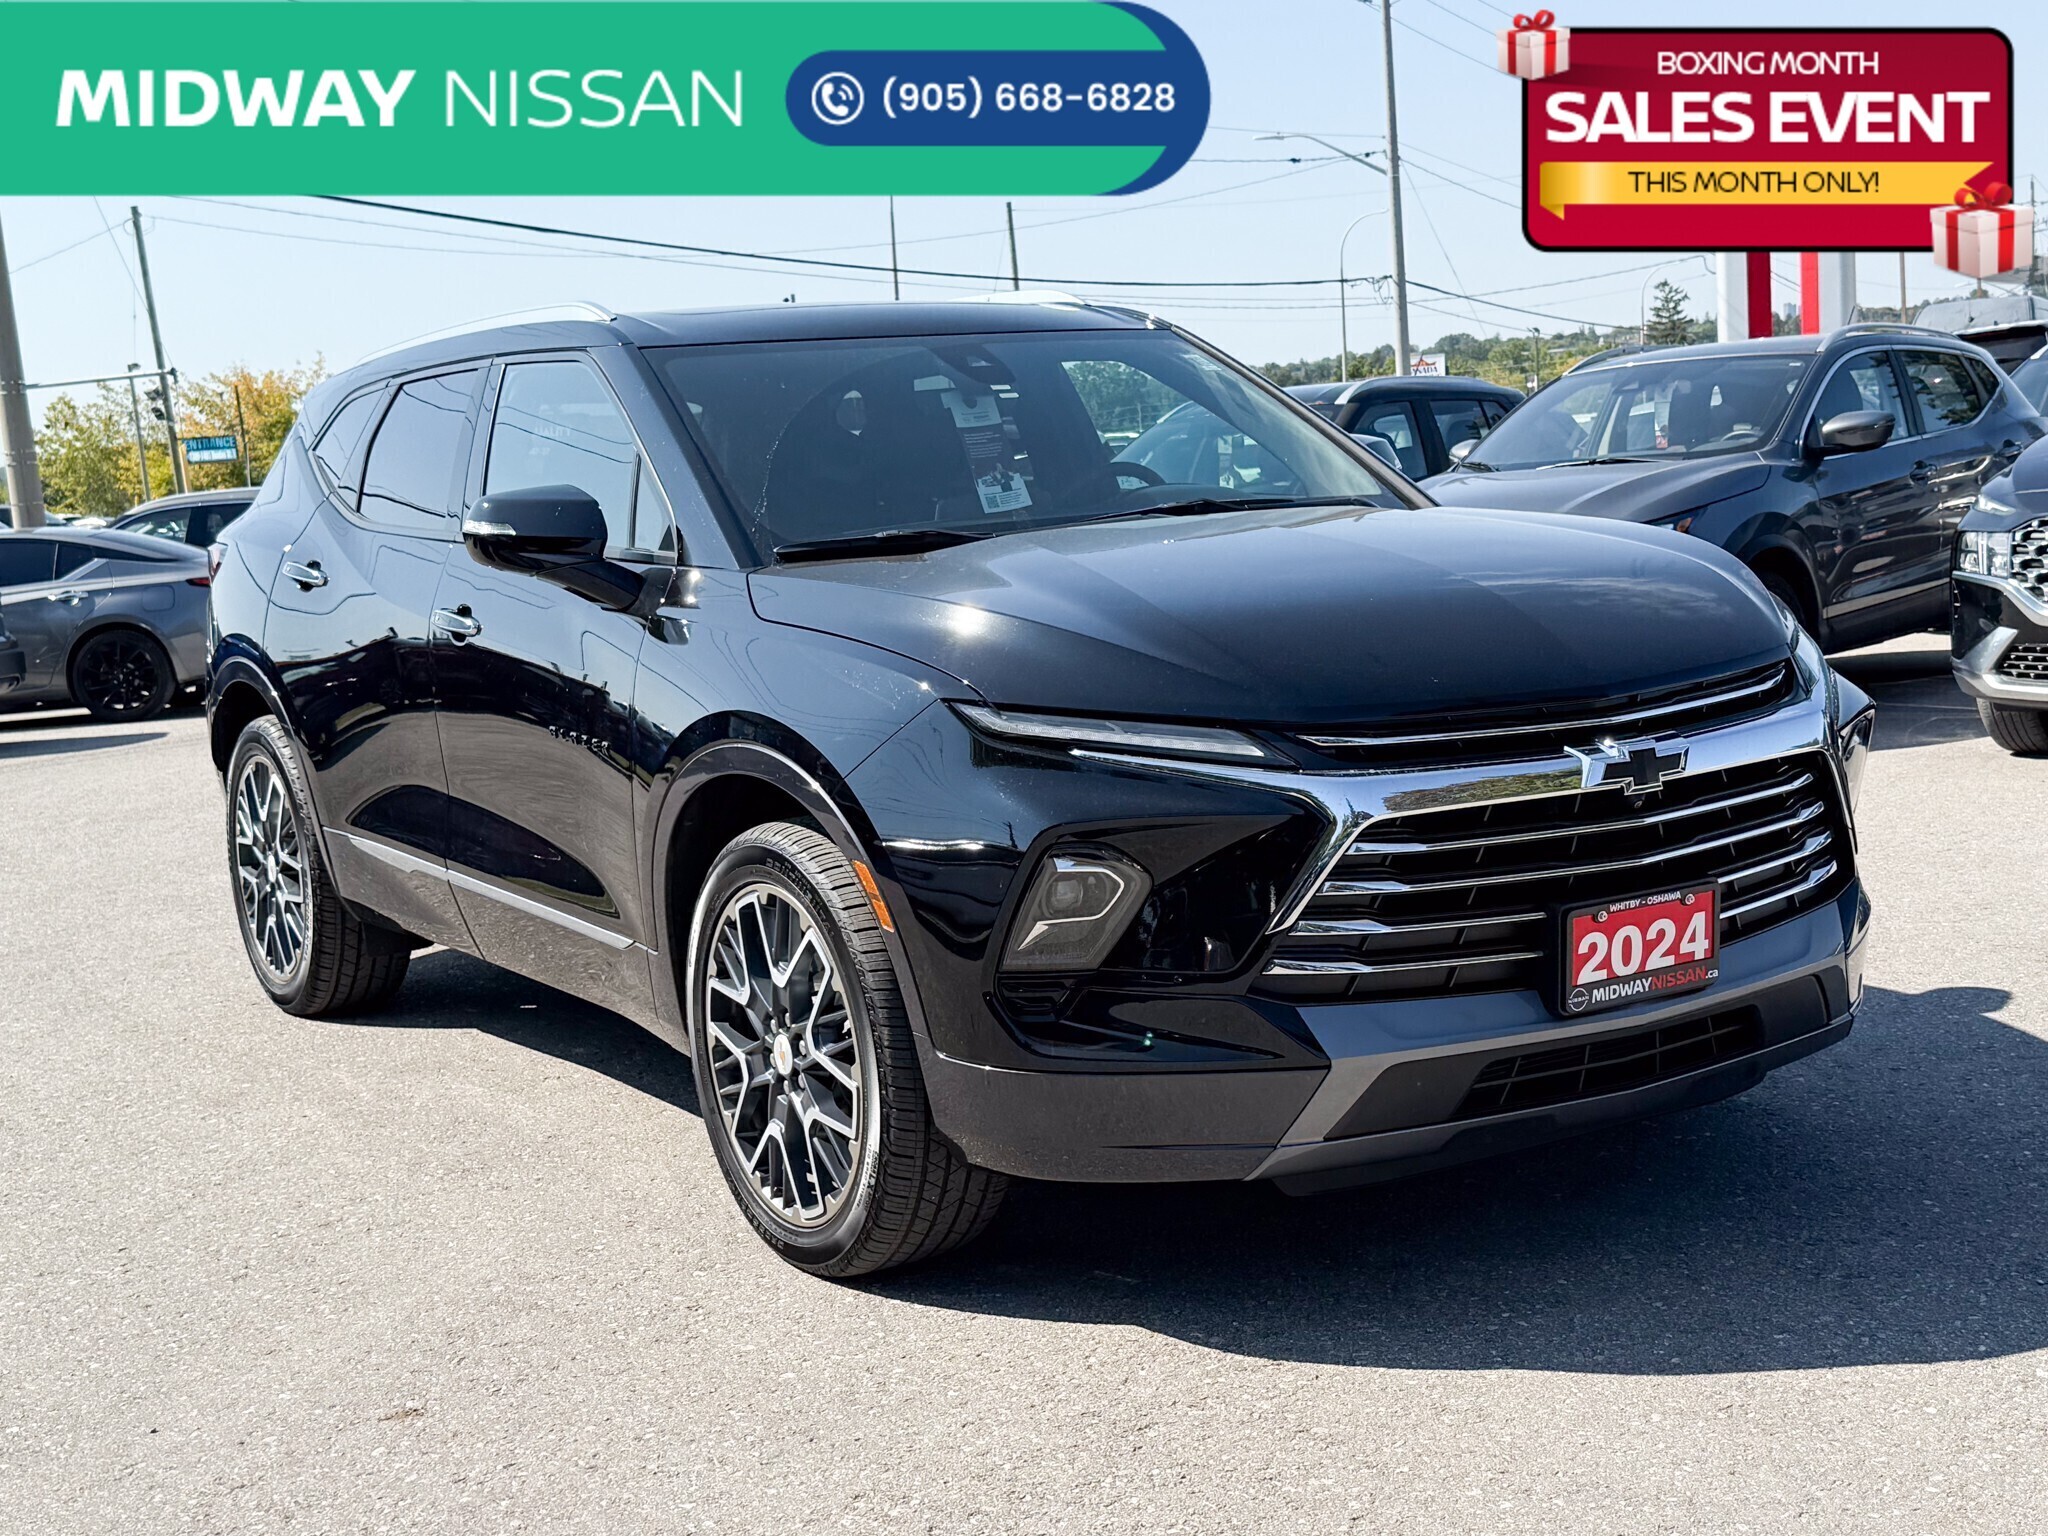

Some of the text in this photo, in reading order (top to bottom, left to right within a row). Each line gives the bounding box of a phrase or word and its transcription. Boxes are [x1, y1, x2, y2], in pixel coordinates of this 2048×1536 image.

[185, 436, 236, 450] ENTRANCE
[1609, 899, 1641, 912] WHITBY
[1647, 891, 1682, 905] OSHAWA
[1577, 911, 1709, 985] 2024
